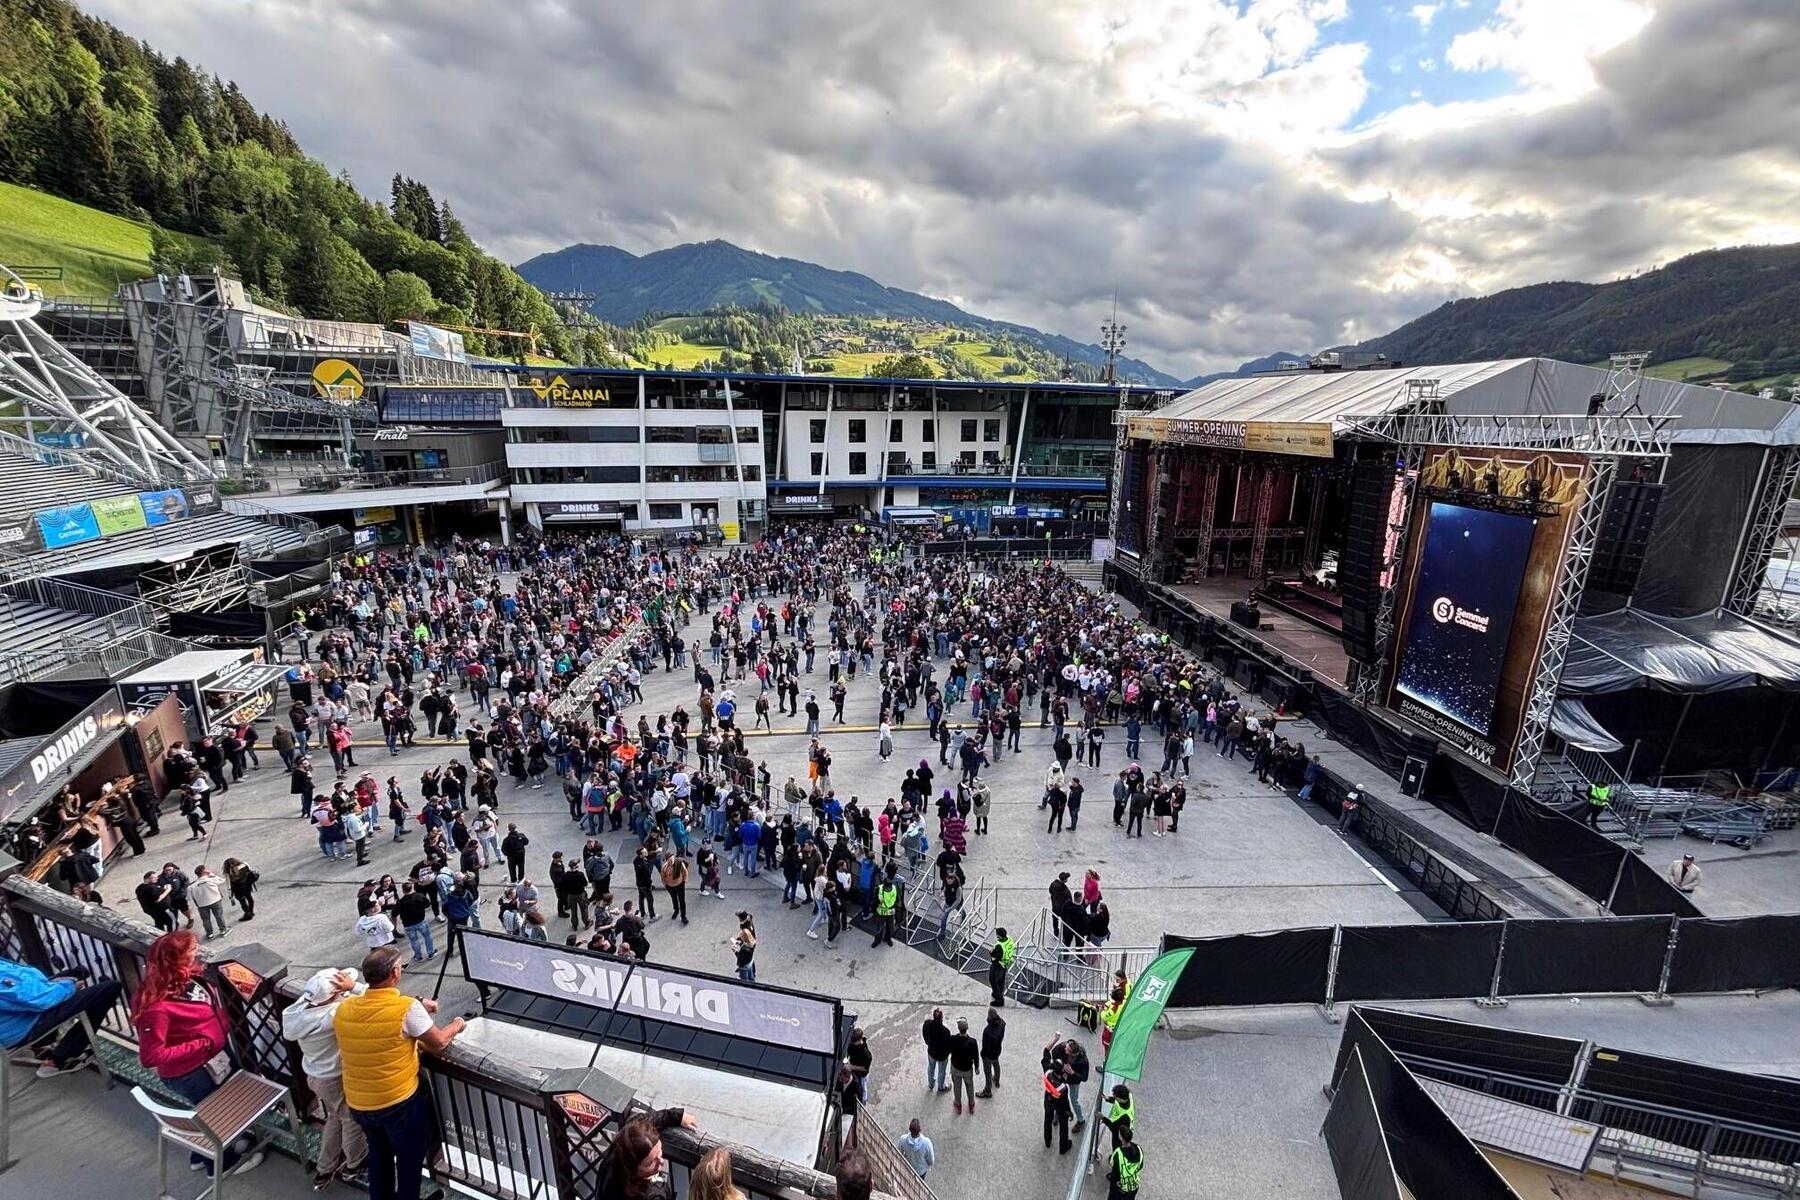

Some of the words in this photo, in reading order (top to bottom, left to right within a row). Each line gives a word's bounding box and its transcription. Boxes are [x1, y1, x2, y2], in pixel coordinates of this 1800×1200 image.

[552, 389, 610, 401] PLANAI
[373, 425, 408, 441] Finale
[1167, 421, 1246, 437] SUMMER-OPENING
[561, 503, 600, 513] DRINKS
[785, 496, 818, 504] DRINKS
[1001, 505, 1016, 515] WC
[1454, 615, 1487, 633] Concerts
[1455, 607, 1490, 626] Semmel
[1401, 700, 1474, 742] SUMMER-OPENING
[30, 715, 97, 784] DRINKS
